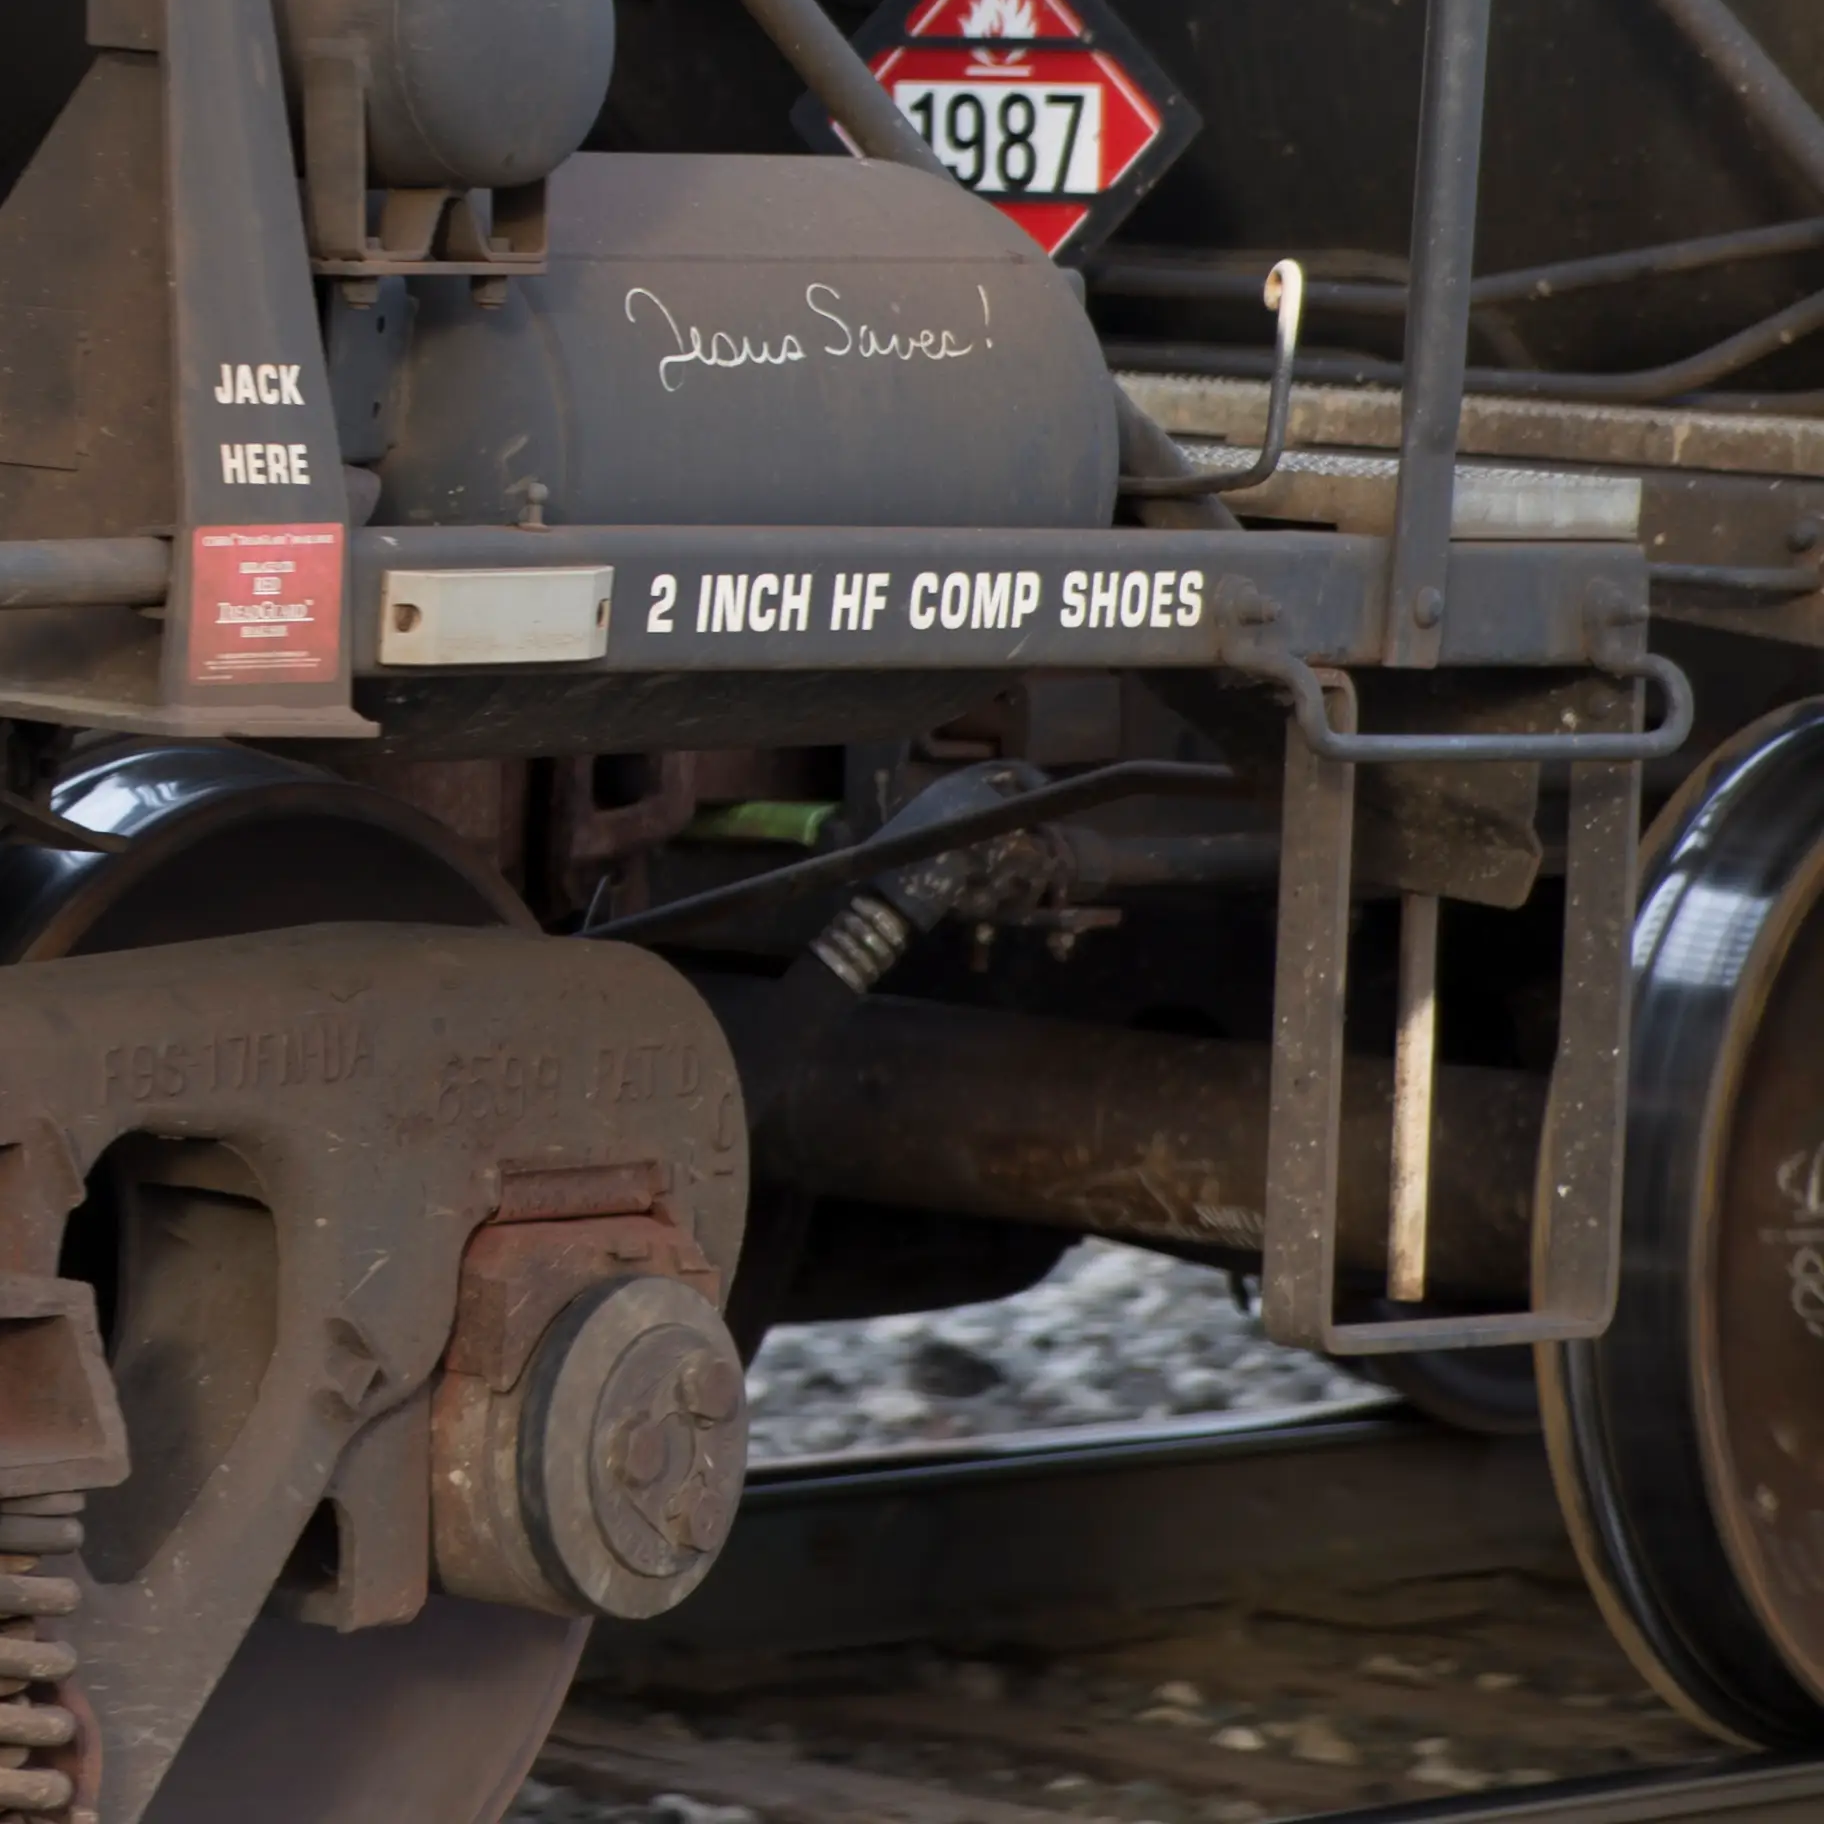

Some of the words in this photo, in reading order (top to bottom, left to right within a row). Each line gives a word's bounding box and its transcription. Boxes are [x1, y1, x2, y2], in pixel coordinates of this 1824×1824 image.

[909, 90, 1085, 193] 1987
[625, 287, 807, 392] Jesus
[215, 363, 303, 405] JACK
[221, 442, 311, 485] HERE
[647, 574, 674, 634] 2
[695, 573, 813, 633] INCH
[830, 572, 889, 631] HF
[908, 571, 1040, 629] COMP
[1059, 569, 1205, 628] SHOES
